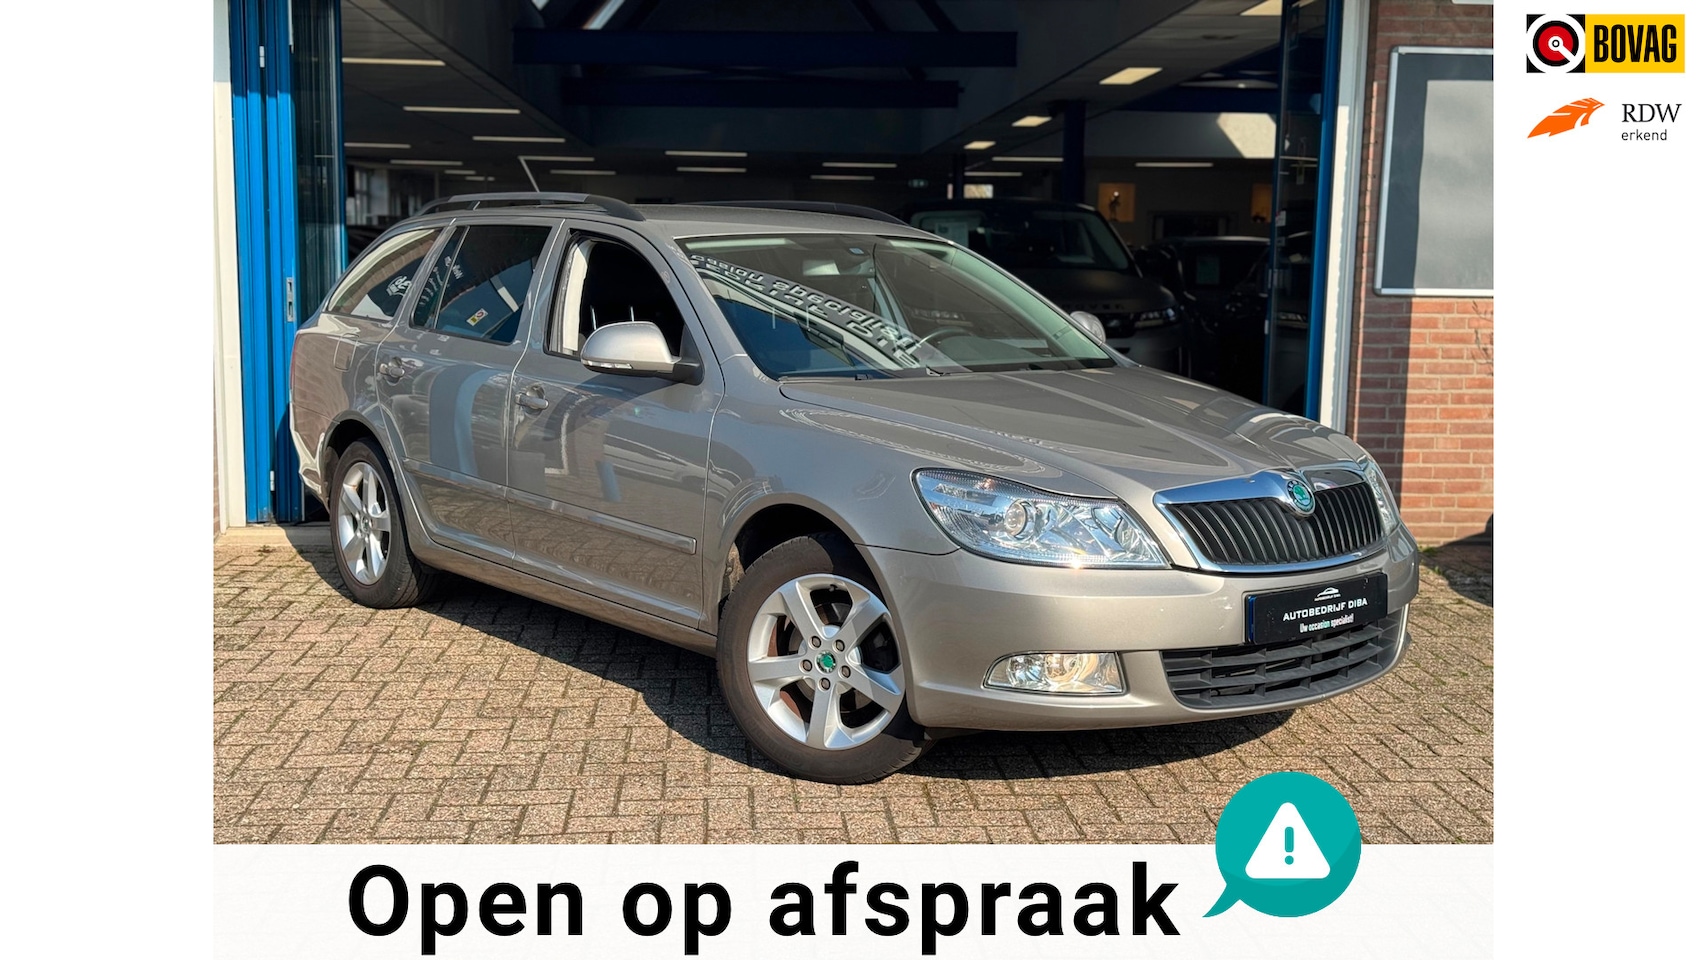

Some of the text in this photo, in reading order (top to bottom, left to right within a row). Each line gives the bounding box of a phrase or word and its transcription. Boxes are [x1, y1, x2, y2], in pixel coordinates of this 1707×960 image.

[1282, 602, 1346, 622] AUTOBEDRIJF
[1347, 597, 1368, 610] DIBA
[1308, 619, 1332, 631] occasion
